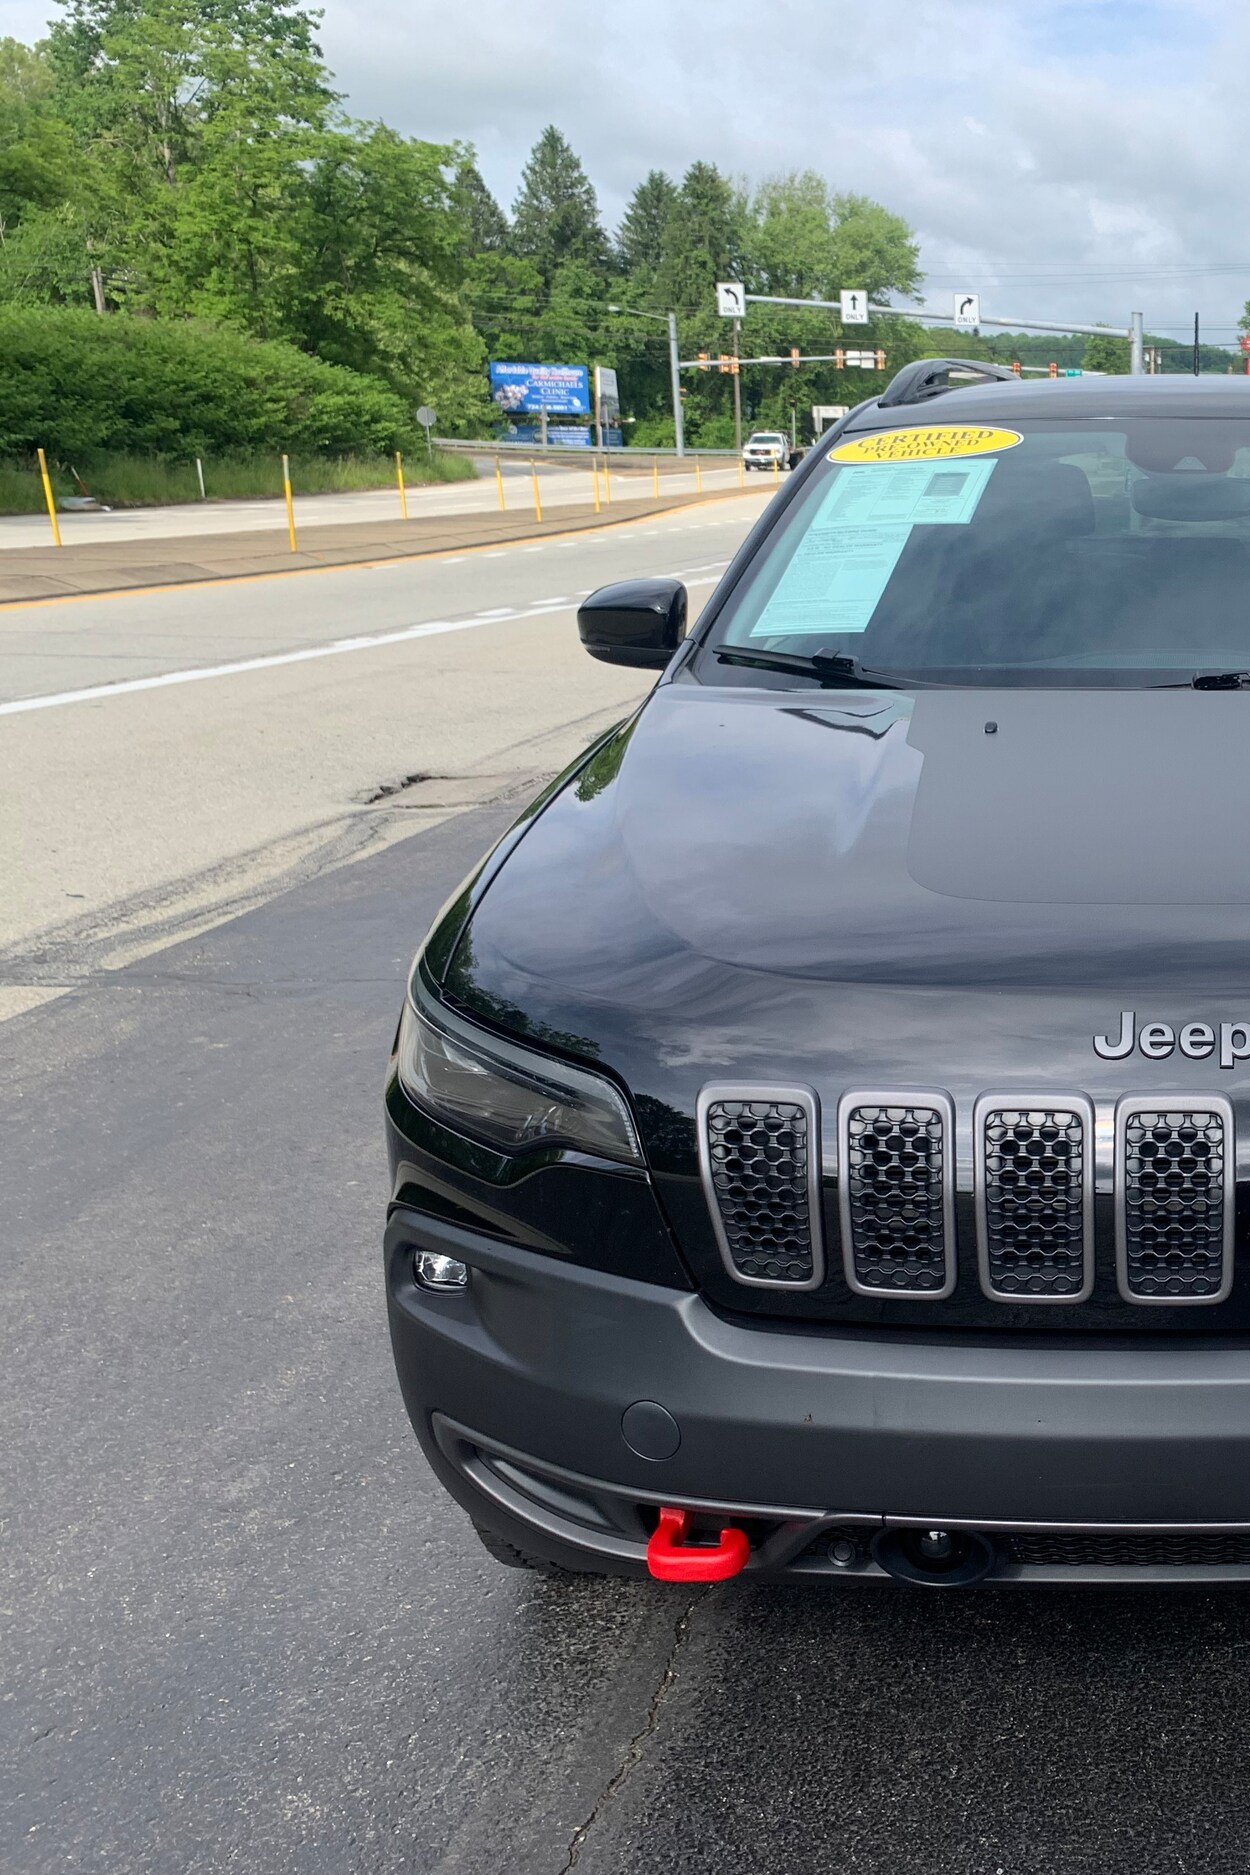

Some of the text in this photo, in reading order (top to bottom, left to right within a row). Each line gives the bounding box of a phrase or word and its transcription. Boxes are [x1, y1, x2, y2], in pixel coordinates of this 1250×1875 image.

[722, 305, 742, 314] ONLY
[845, 312, 864, 321] ONLY
[956, 316, 976, 324] ONLY
[857, 429, 995, 449] CERTIFIED
[863, 438, 981, 455] PRE-OWNED
[875, 447, 962, 460] VEHICLE
